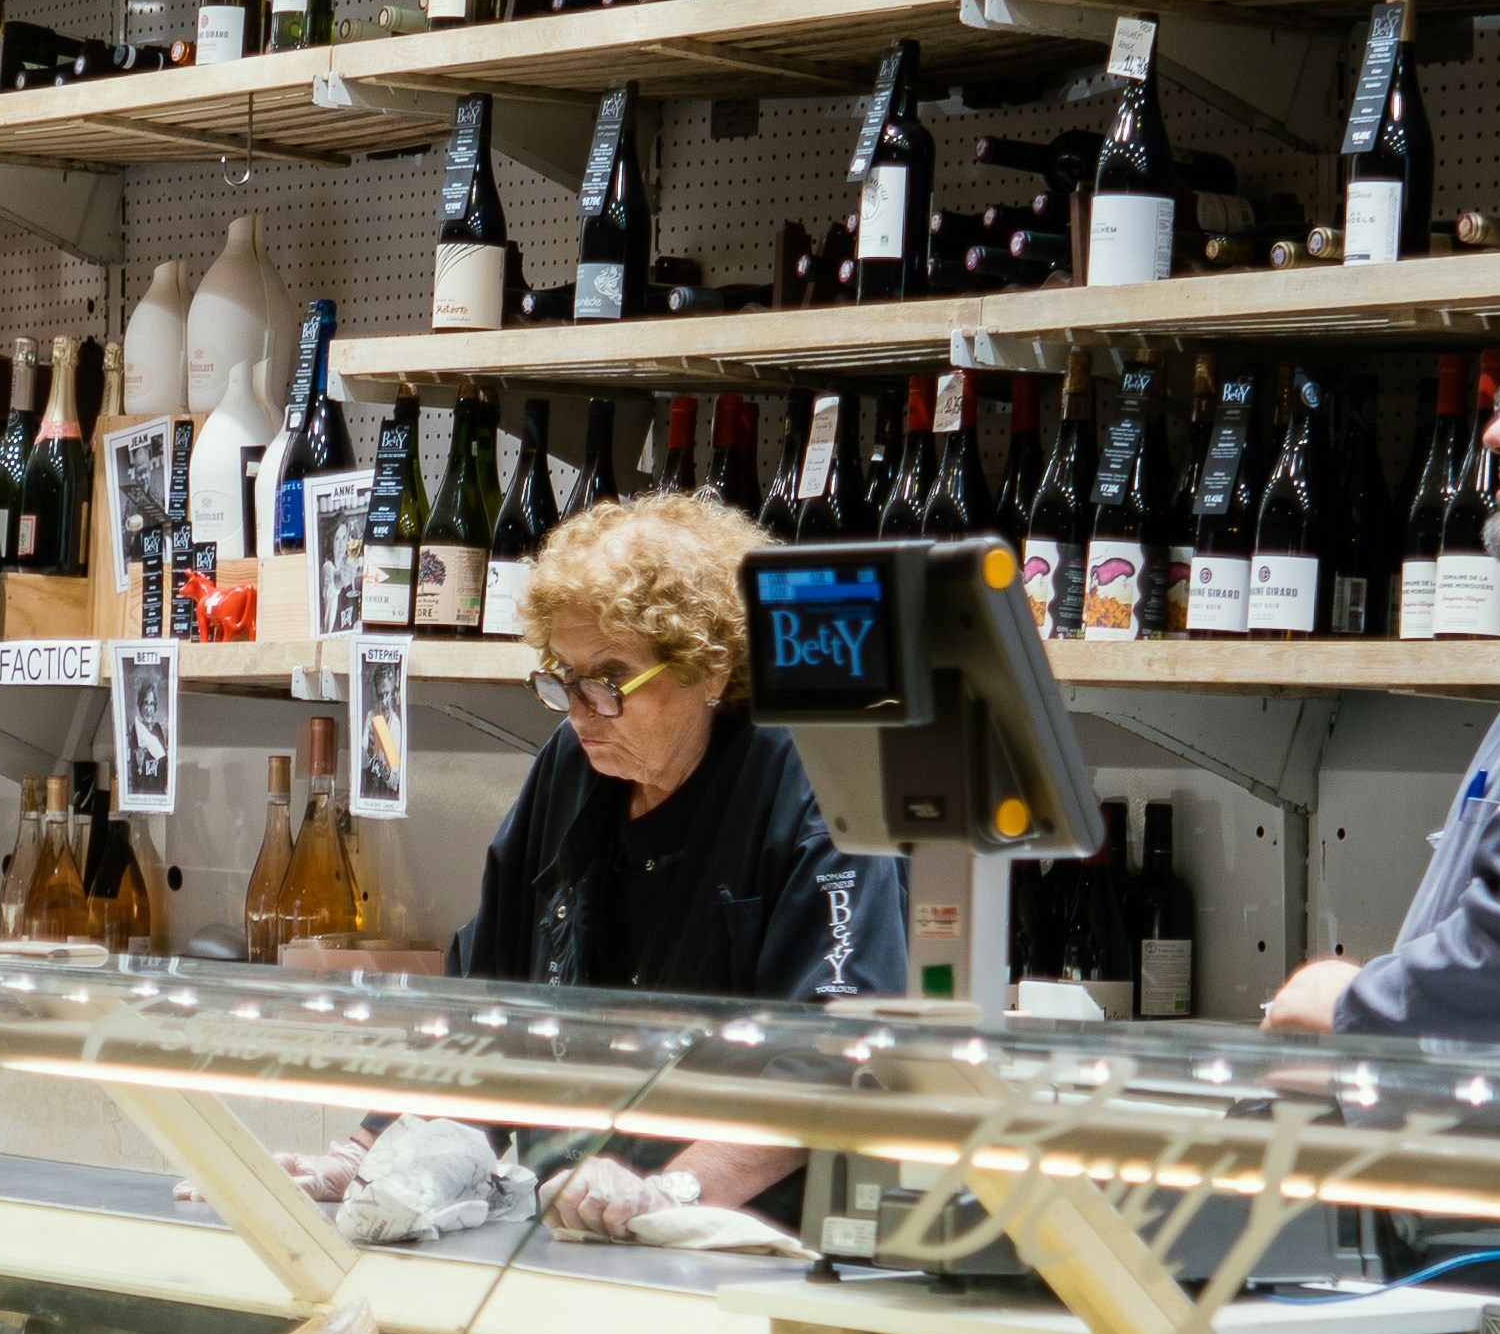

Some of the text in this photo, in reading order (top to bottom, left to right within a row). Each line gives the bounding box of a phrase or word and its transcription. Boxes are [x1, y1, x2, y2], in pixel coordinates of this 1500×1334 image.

[130, 433, 149, 449] JEAN
[333, 484, 355, 499] ANNE
[0, 645, 92, 683] FACTICE
[136, 651, 160, 665] BETTY
